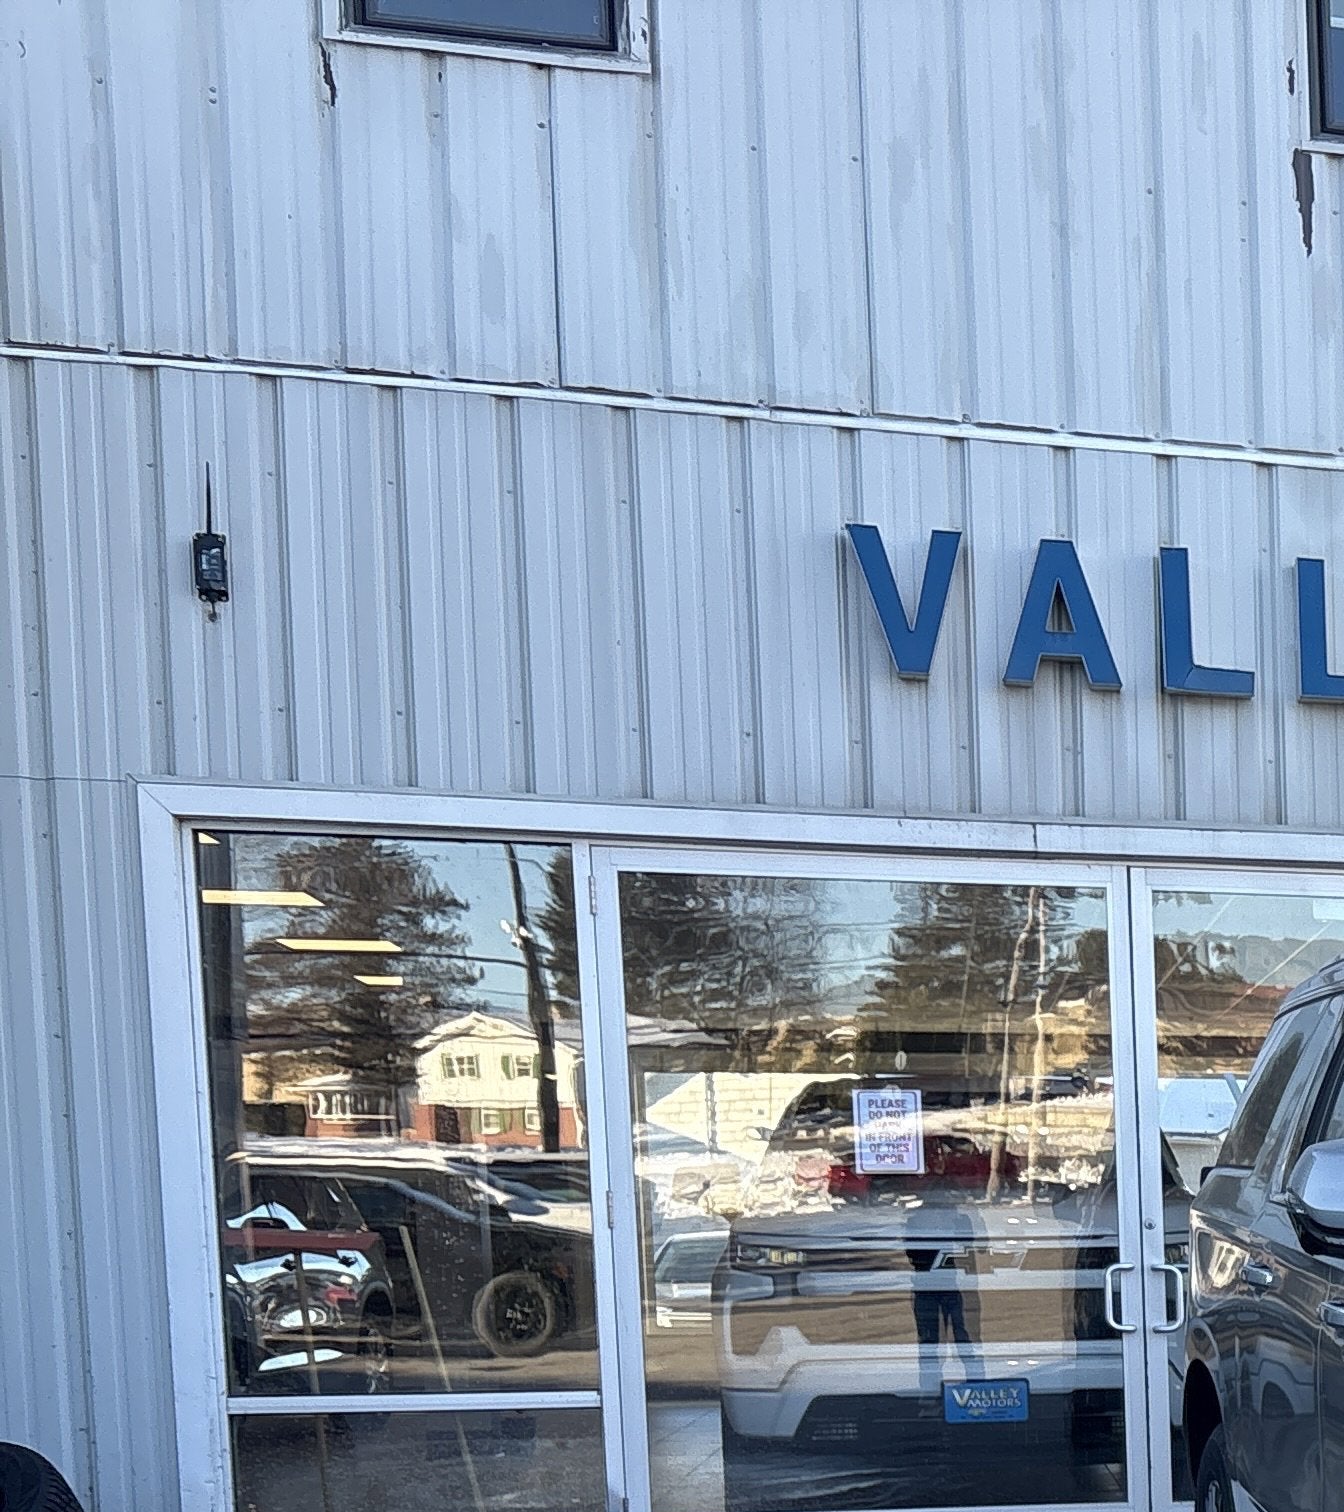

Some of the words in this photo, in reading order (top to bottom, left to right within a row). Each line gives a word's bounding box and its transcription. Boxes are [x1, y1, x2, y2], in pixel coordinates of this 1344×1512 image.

[868, 1099, 907, 1108] PLEASE
[869, 1110, 883, 1119] DO
[886, 1110, 907, 1119] NOT
[865, 1132, 877, 1142] IN
[879, 1132, 912, 1143] FRONT
[869, 1144, 882, 1153] OF
[952, 1388, 1020, 1407] VALLEY
[967, 1399, 1022, 1408] MOTORS
